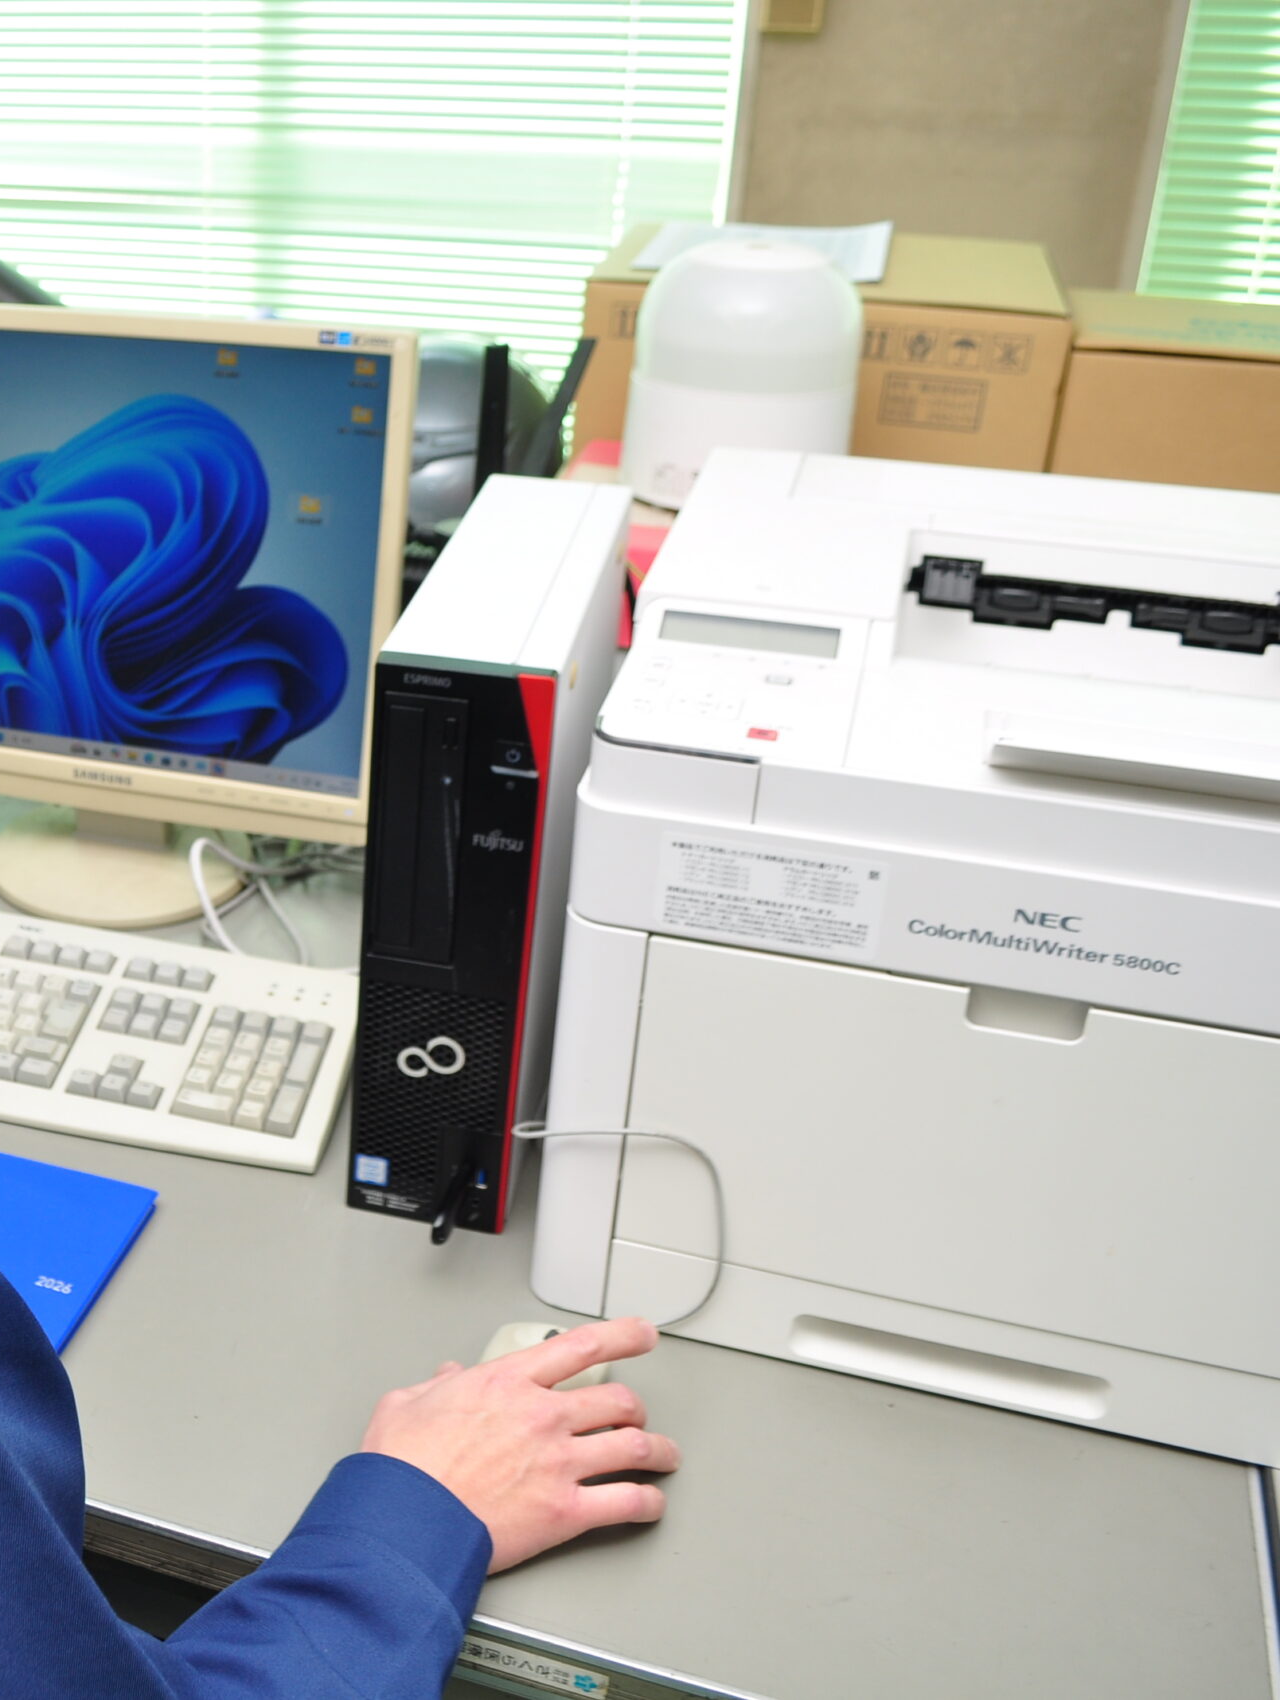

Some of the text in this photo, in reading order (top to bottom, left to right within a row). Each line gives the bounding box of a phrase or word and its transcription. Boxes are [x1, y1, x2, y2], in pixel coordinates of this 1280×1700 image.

[472, 829, 524, 852] FUJITSU
[1013, 908, 1083, 933] NEC
[907, 919, 1109, 964] ColorMultiWriter
[1112, 953, 1182, 976] 5800C
[34, 1275, 73, 1295] 2026
